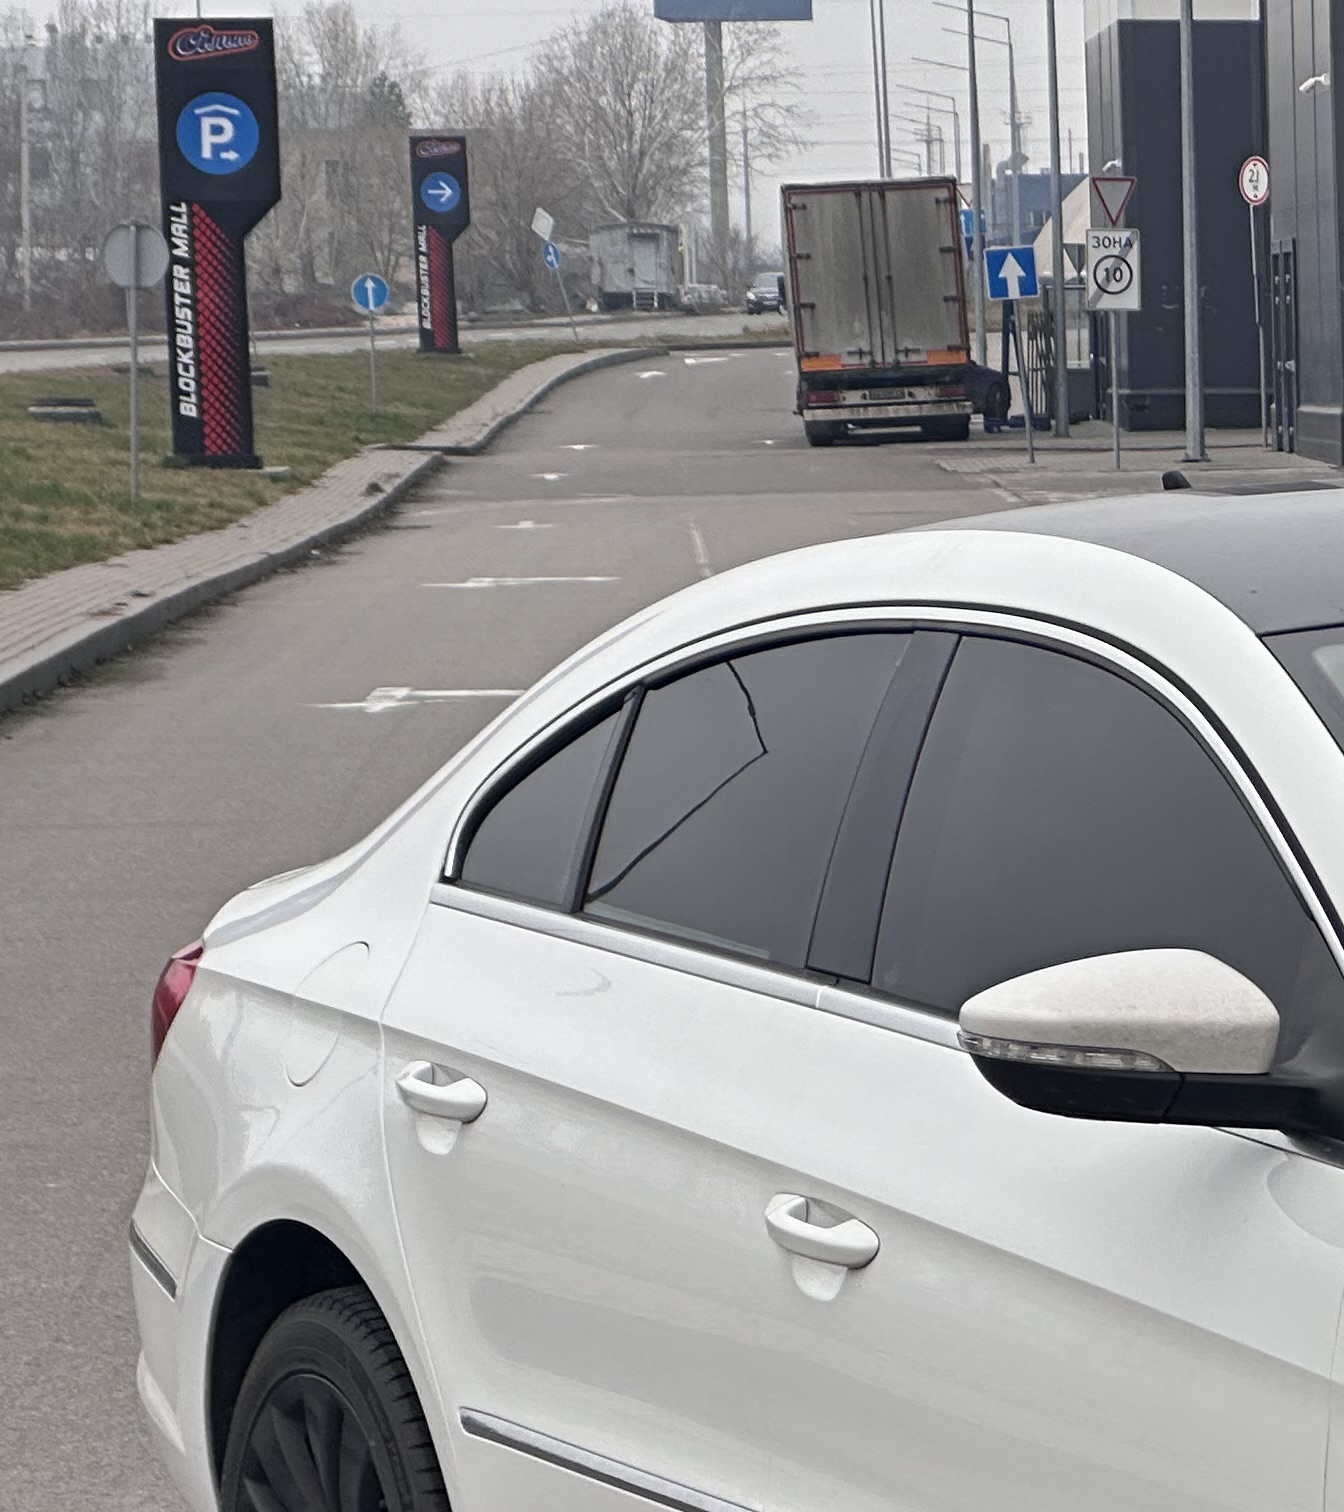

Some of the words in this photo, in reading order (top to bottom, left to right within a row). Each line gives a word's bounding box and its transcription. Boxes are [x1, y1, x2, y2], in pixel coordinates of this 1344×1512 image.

[201, 117, 234, 159] P
[170, 202, 190, 258] MALL
[1092, 235, 1133, 249] ЗОНА
[1104, 266, 1124, 283] 10
[173, 265, 198, 418] BLOCKBUSTER
